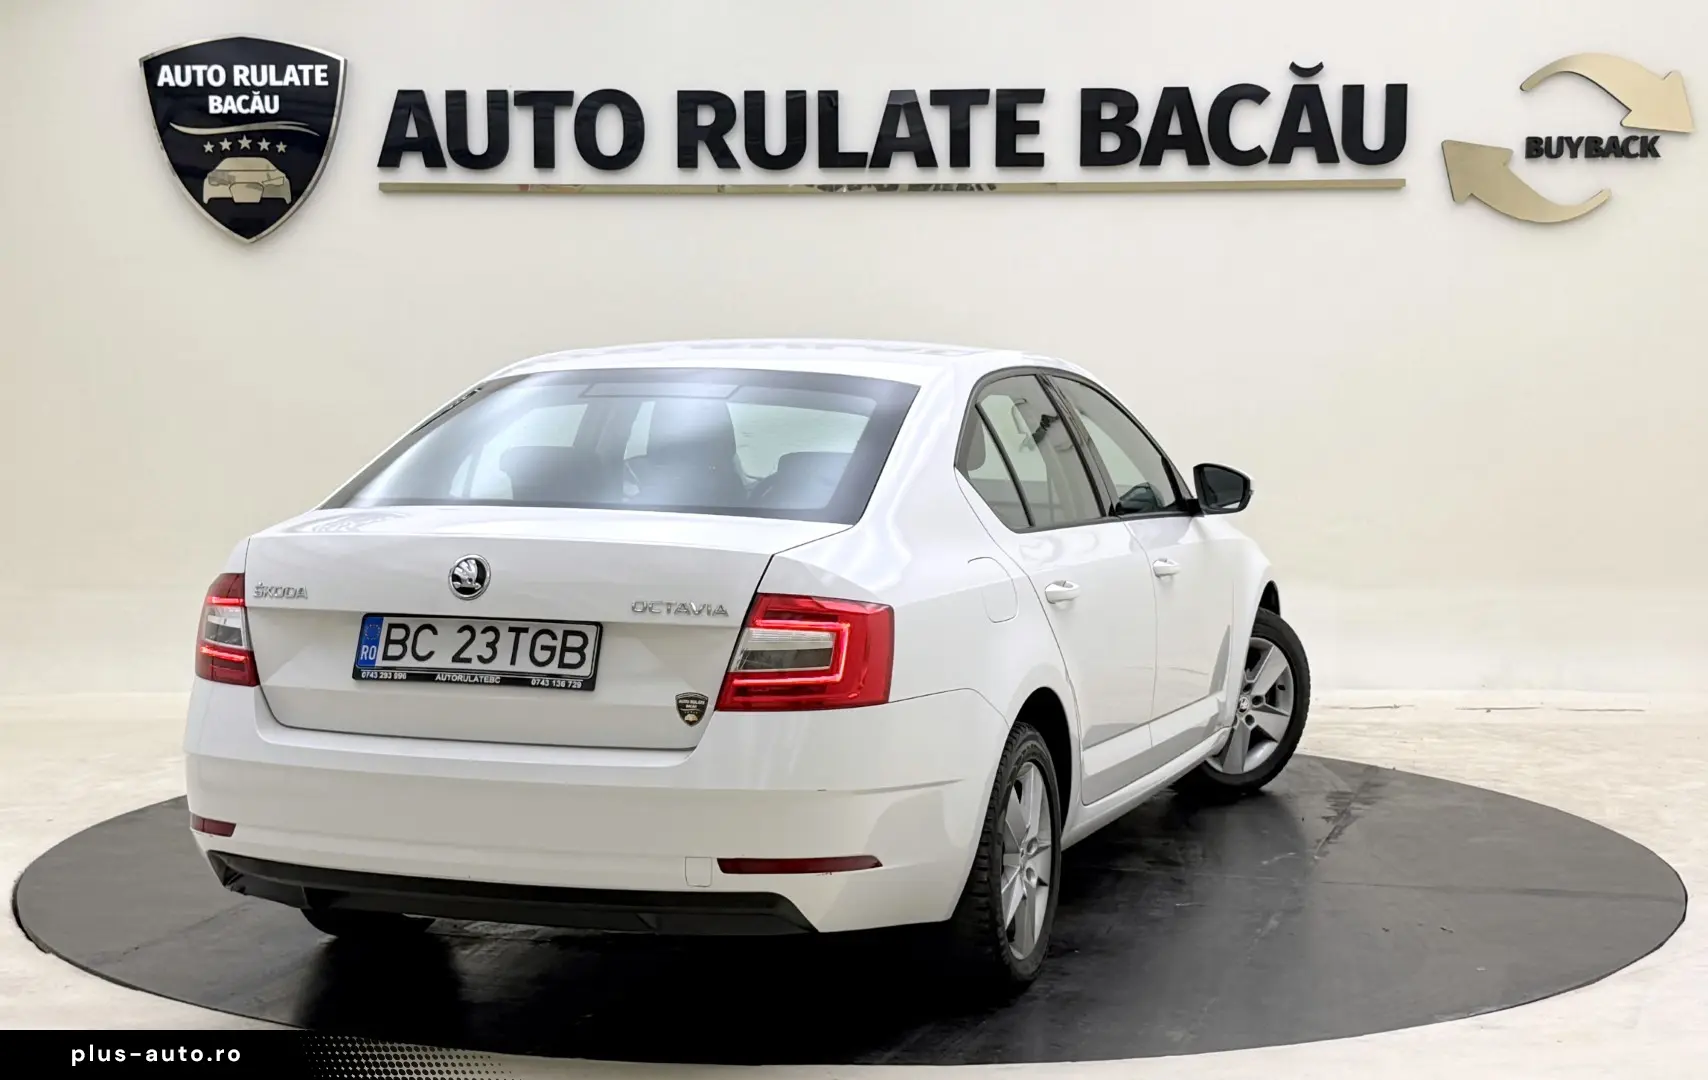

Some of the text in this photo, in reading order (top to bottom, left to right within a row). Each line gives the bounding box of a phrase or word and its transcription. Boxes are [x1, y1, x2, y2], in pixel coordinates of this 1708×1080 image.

[156, 64, 330, 88] AUTO RULATE
[208, 90, 280, 115] BACĂU
[377, 61, 1408, 171] AUTO RULATE BACĂU
[1524, 135, 1662, 160] BUYBACK
[631, 600, 729, 617] OCTAVIA
[360, 644, 377, 662] RO
[382, 622, 439, 663] BC
